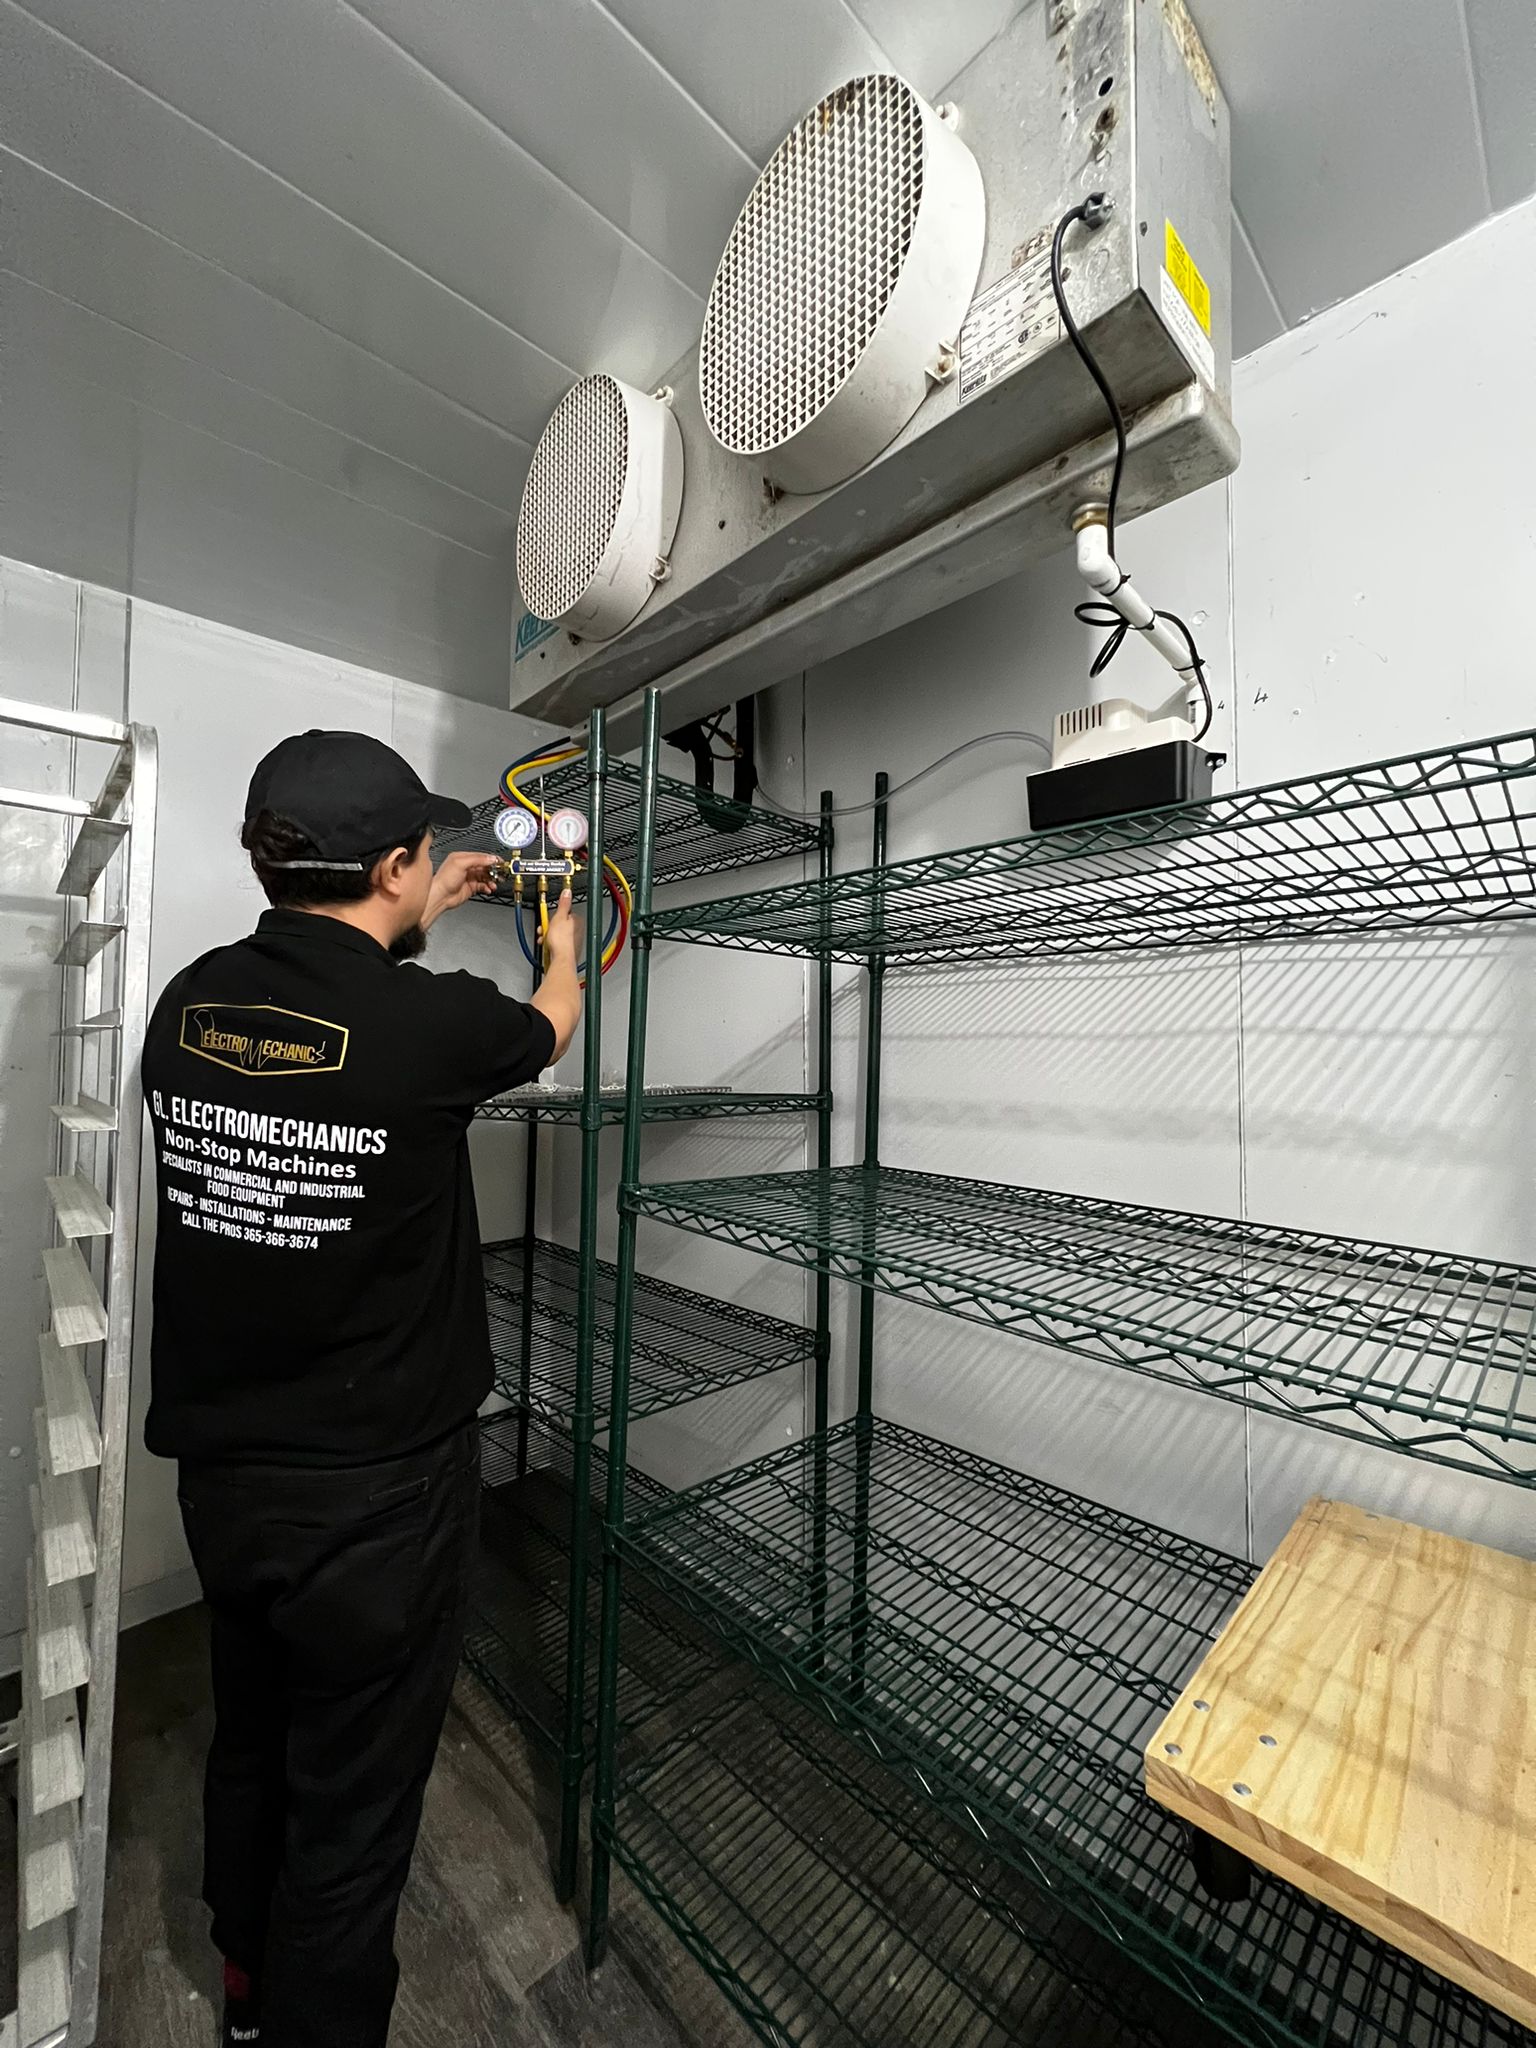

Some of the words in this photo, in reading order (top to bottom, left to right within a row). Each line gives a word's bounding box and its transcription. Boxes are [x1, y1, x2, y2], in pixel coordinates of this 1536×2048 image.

[172, 1096, 388, 1155] ELECTROMECHANICS
[162, 1150, 202, 1175] SPECIALISTS
[203, 1163, 213, 1178] IN
[213, 1166, 273, 1192] COMMERCIAL
[274, 1179, 298, 1195] AND
[300, 1182, 365, 1199] INDUSTRIAL
[165, 1127, 241, 1167] Non-Stop
[247, 1148, 357, 1179] Machines
[200, 1197, 265, 1225] INSTALLATIONS
[273, 1214, 352, 1232] MAINTENANCE
[207, 1180, 229, 1197] FOOD
[230, 1185, 286, 1209] EQUIPMENT
[182, 1211, 201, 1229] CALL
[202, 1216, 219, 1233] THE
[219, 1221, 242, 1239] PROS
[243, 1227, 319, 1249] 365-366-3674
